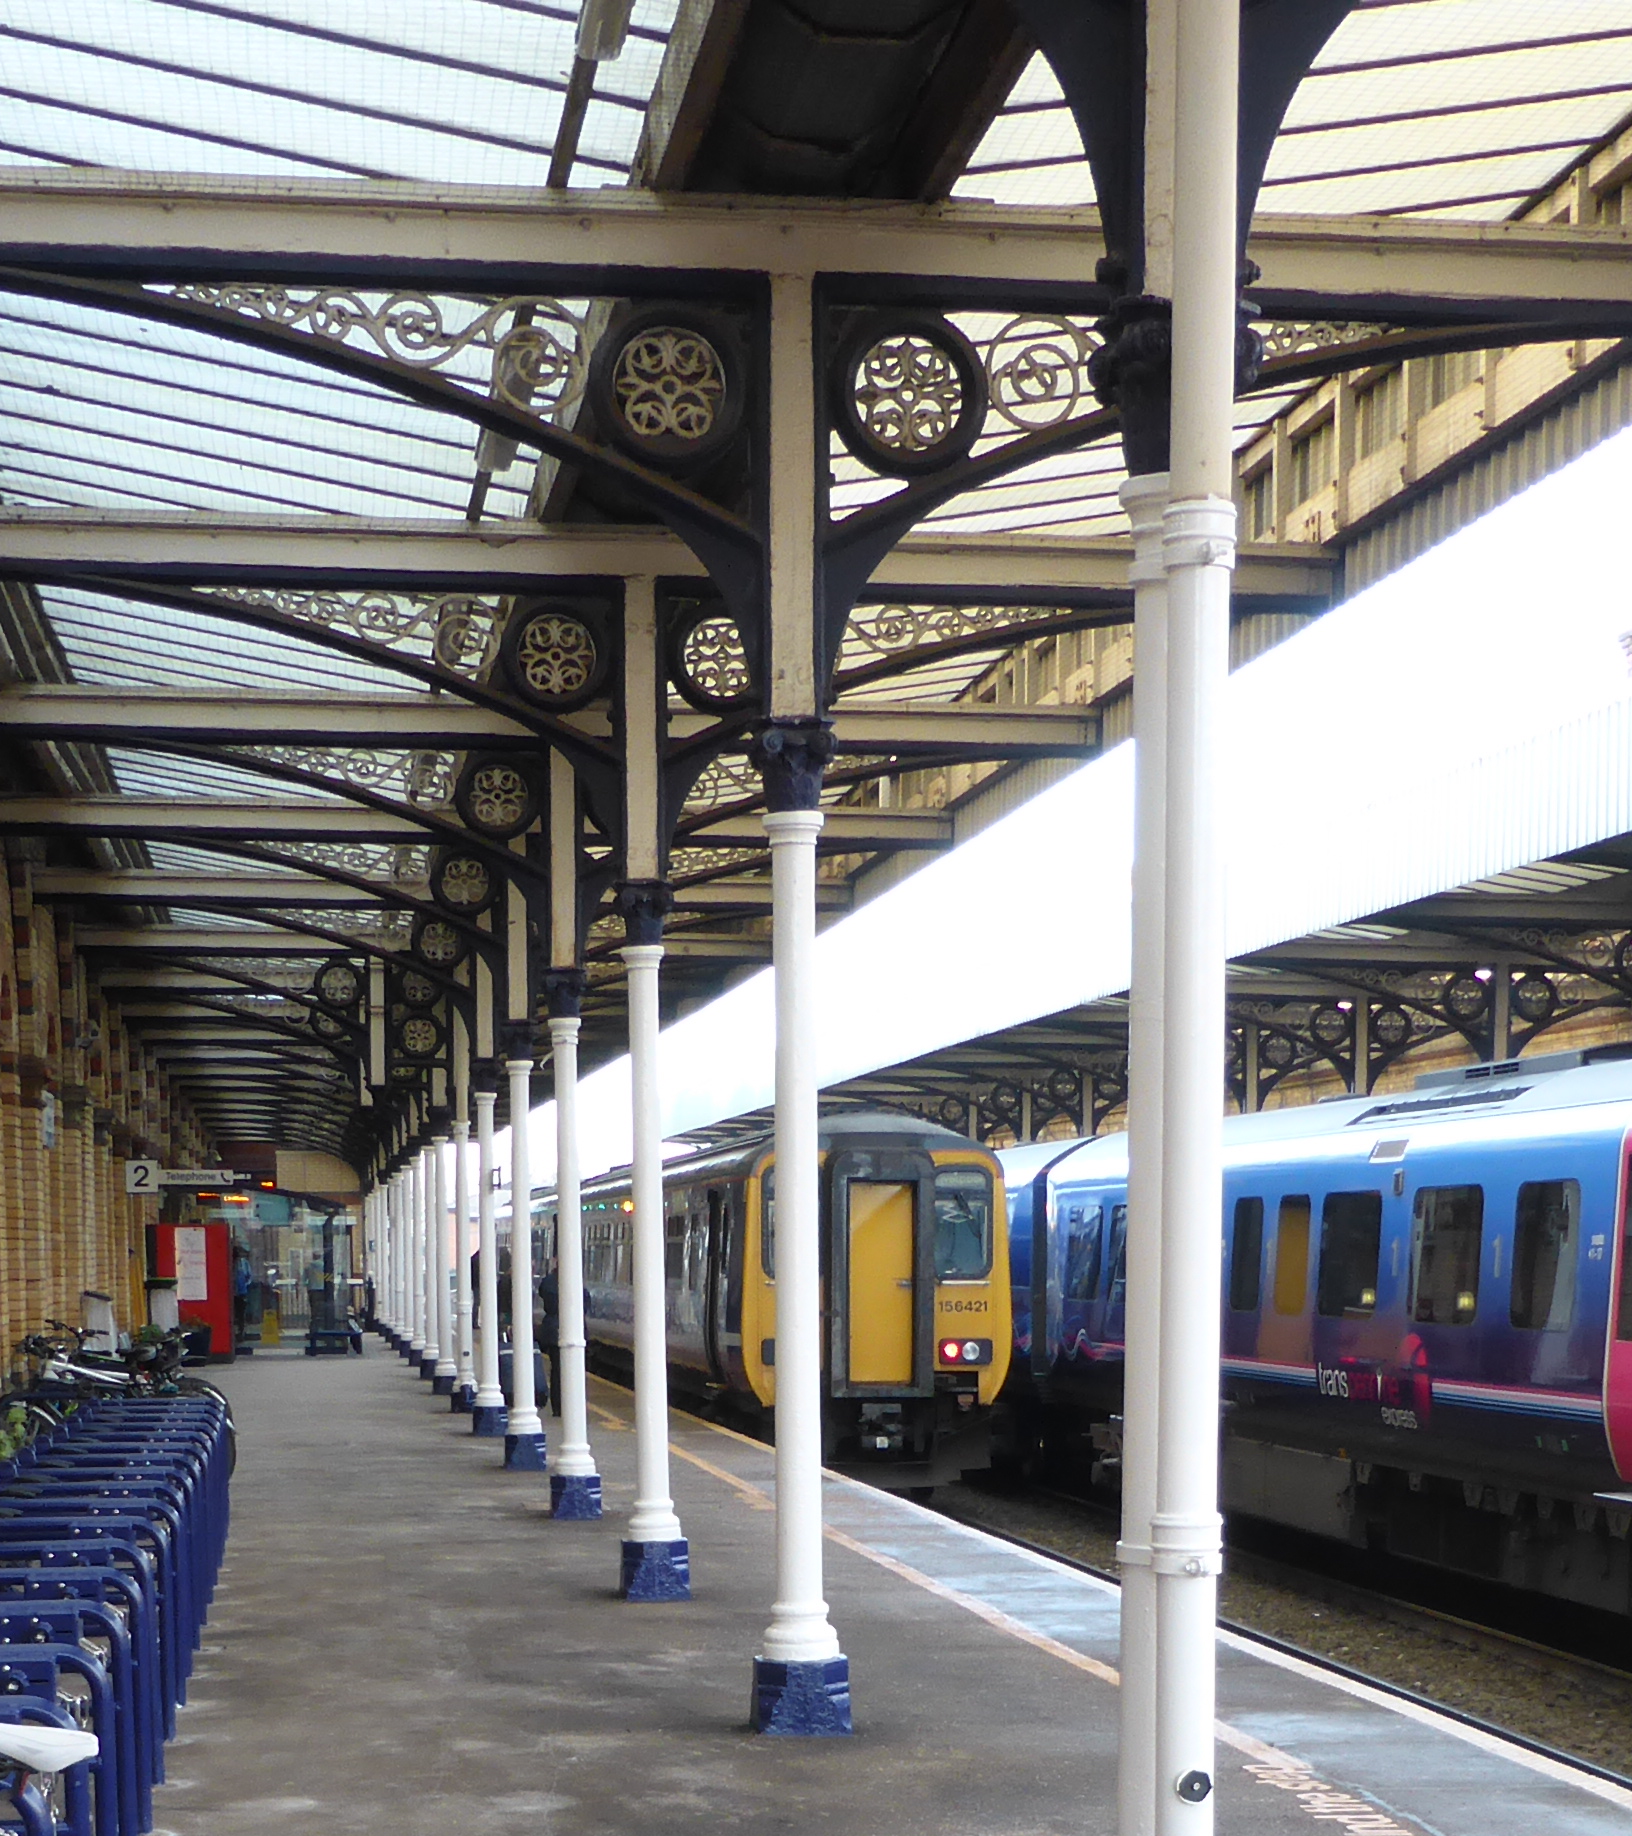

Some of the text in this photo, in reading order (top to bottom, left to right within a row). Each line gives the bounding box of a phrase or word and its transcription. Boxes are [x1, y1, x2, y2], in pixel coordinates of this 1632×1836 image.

[133, 1165, 150, 1187] 2
[165, 1171, 217, 1182] Telephone
[938, 1300, 989, 1313] 156421
